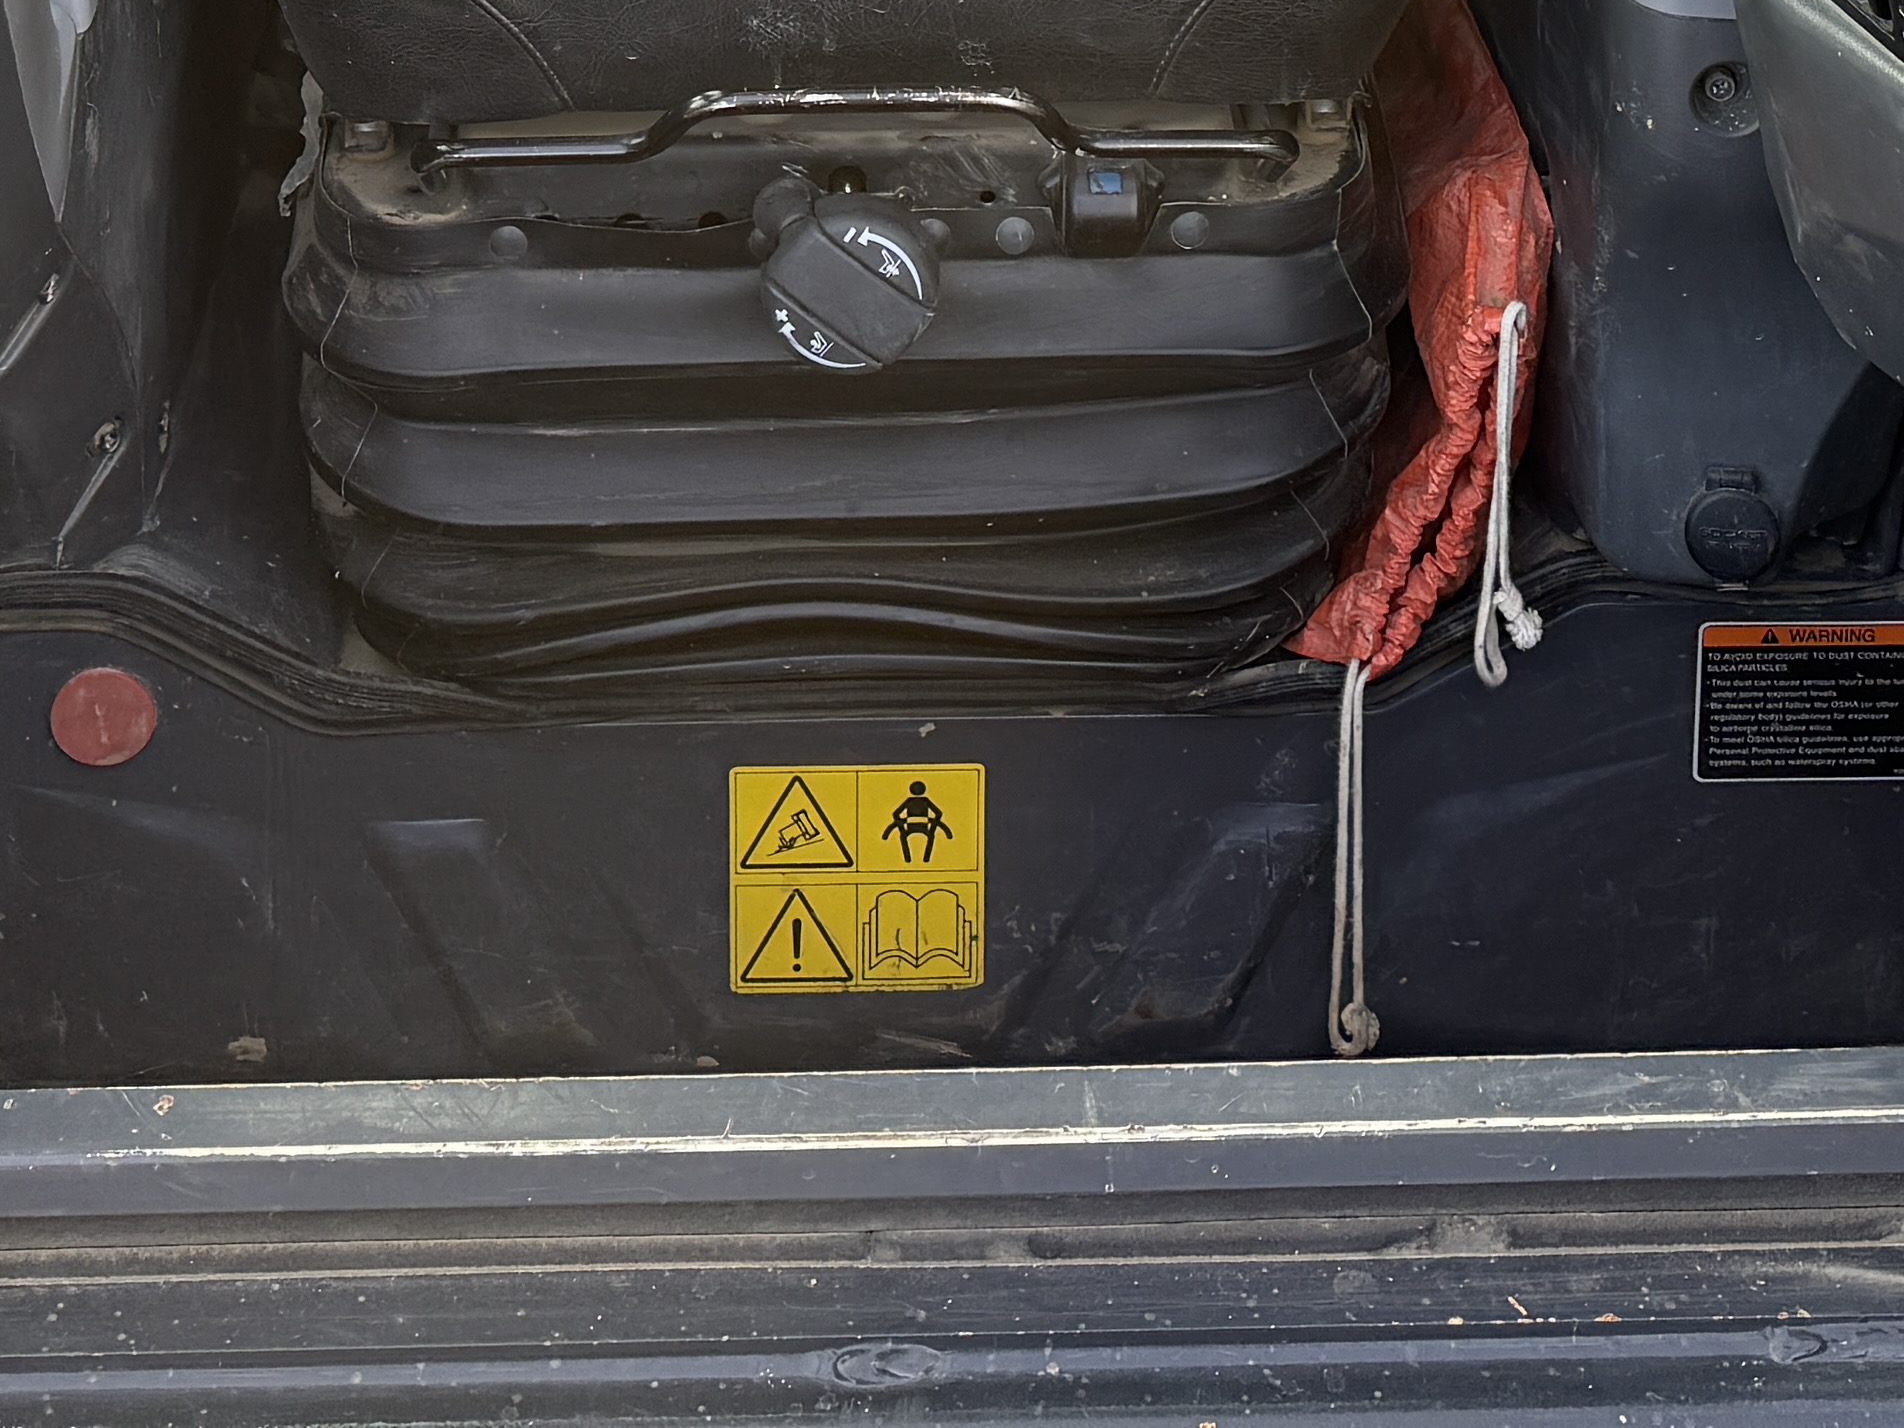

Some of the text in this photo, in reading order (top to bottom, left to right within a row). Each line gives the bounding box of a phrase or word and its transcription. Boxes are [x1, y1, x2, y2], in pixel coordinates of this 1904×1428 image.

[1789, 628, 1876, 644] WARNING
[1707, 652, 1721, 660] TO
[1755, 652, 1809, 660] EXPOSURE
[1812, 652, 1826, 660] TO
[1827, 651, 1854, 660] DUST
[1710, 679, 1731, 687] This
[1731, 678, 1752, 686] dust
[1753, 678, 1771, 686] can
[1772, 678, 1800, 686] cause
[1837, 678, 1863, 686] injury
[1764, 701, 1783, 709] and
[1846, 712, 1890, 721] exposure
[1708, 746, 1750, 754] Personal
[1750, 746, 1796, 754] Protective
[1797, 745, 1846, 754] Equipment
[1847, 745, 1865, 754] and
[1866, 745, 1887, 754] dust
[1749, 758, 1772, 766] such
